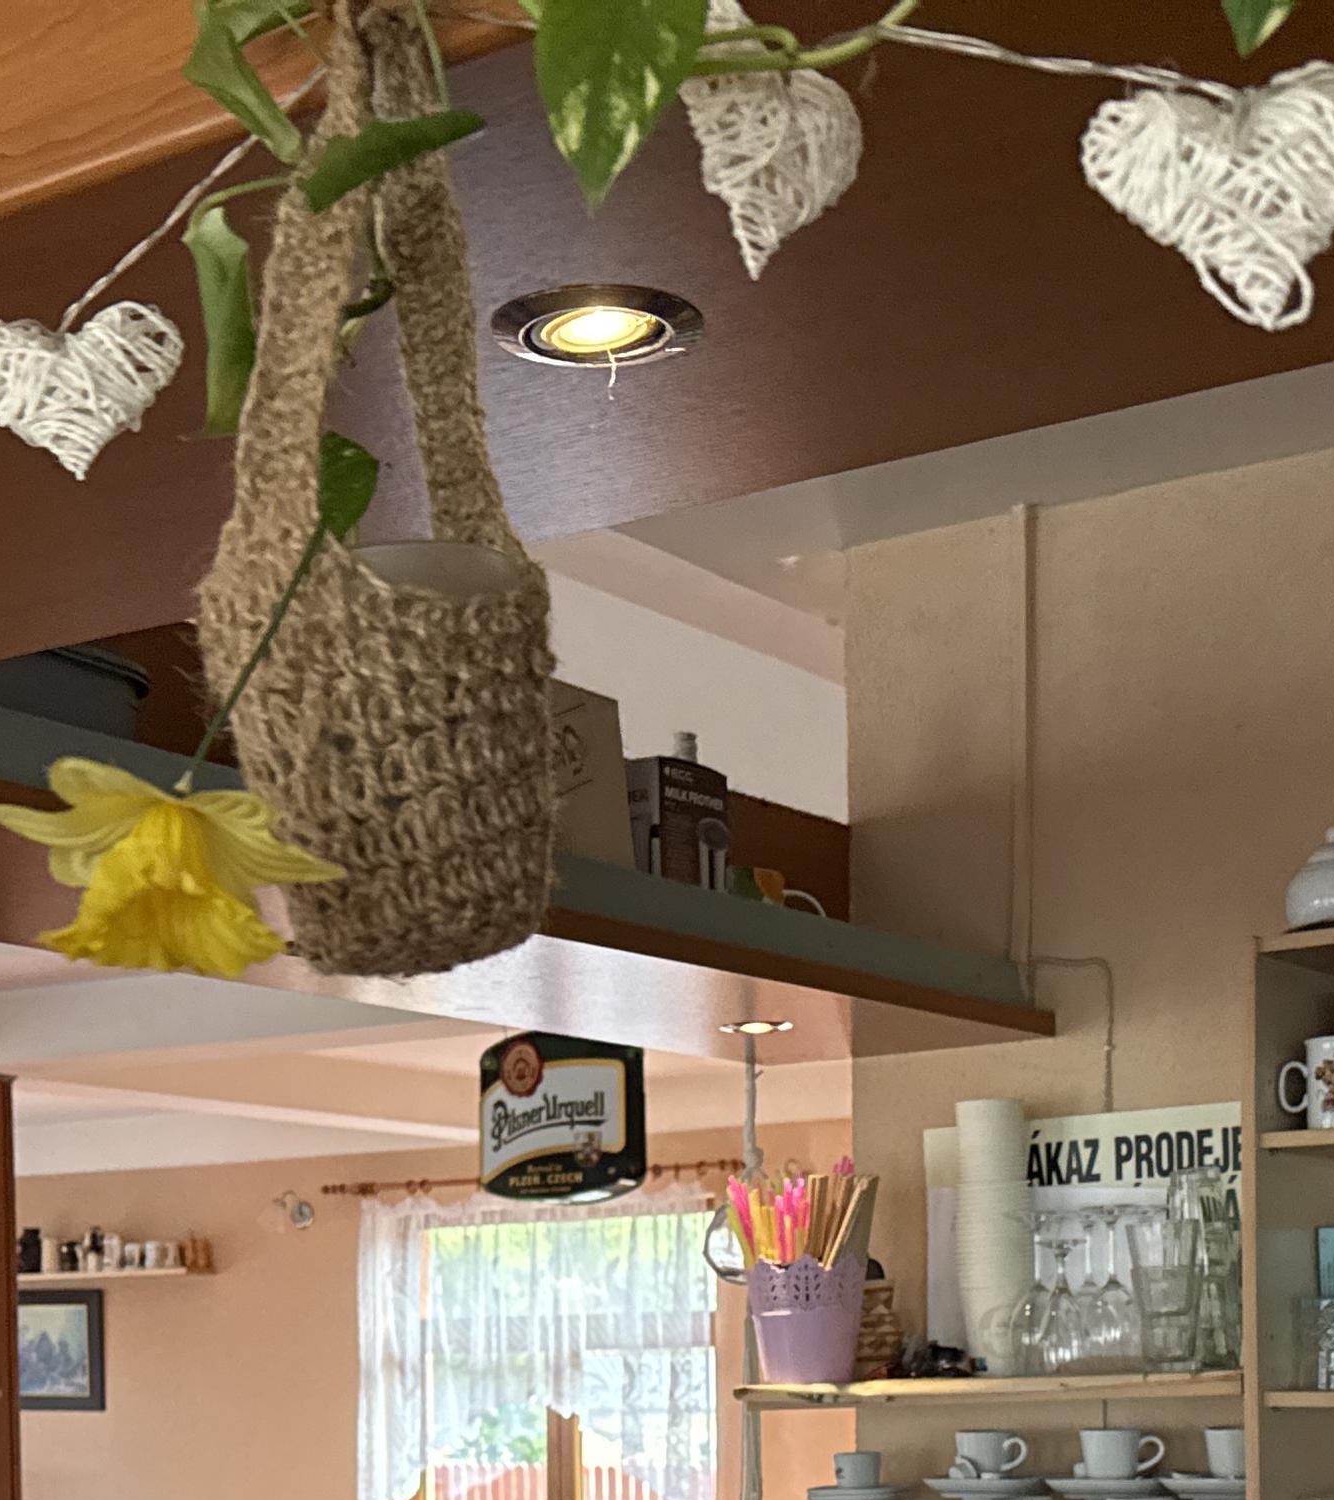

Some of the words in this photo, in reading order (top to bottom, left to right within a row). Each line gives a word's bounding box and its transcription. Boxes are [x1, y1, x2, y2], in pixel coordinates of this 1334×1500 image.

[491, 1100, 545, 1152] Pilsner
[543, 1091, 606, 1130] Urquell
[1025, 1130, 1101, 1188] ÁKAZ
